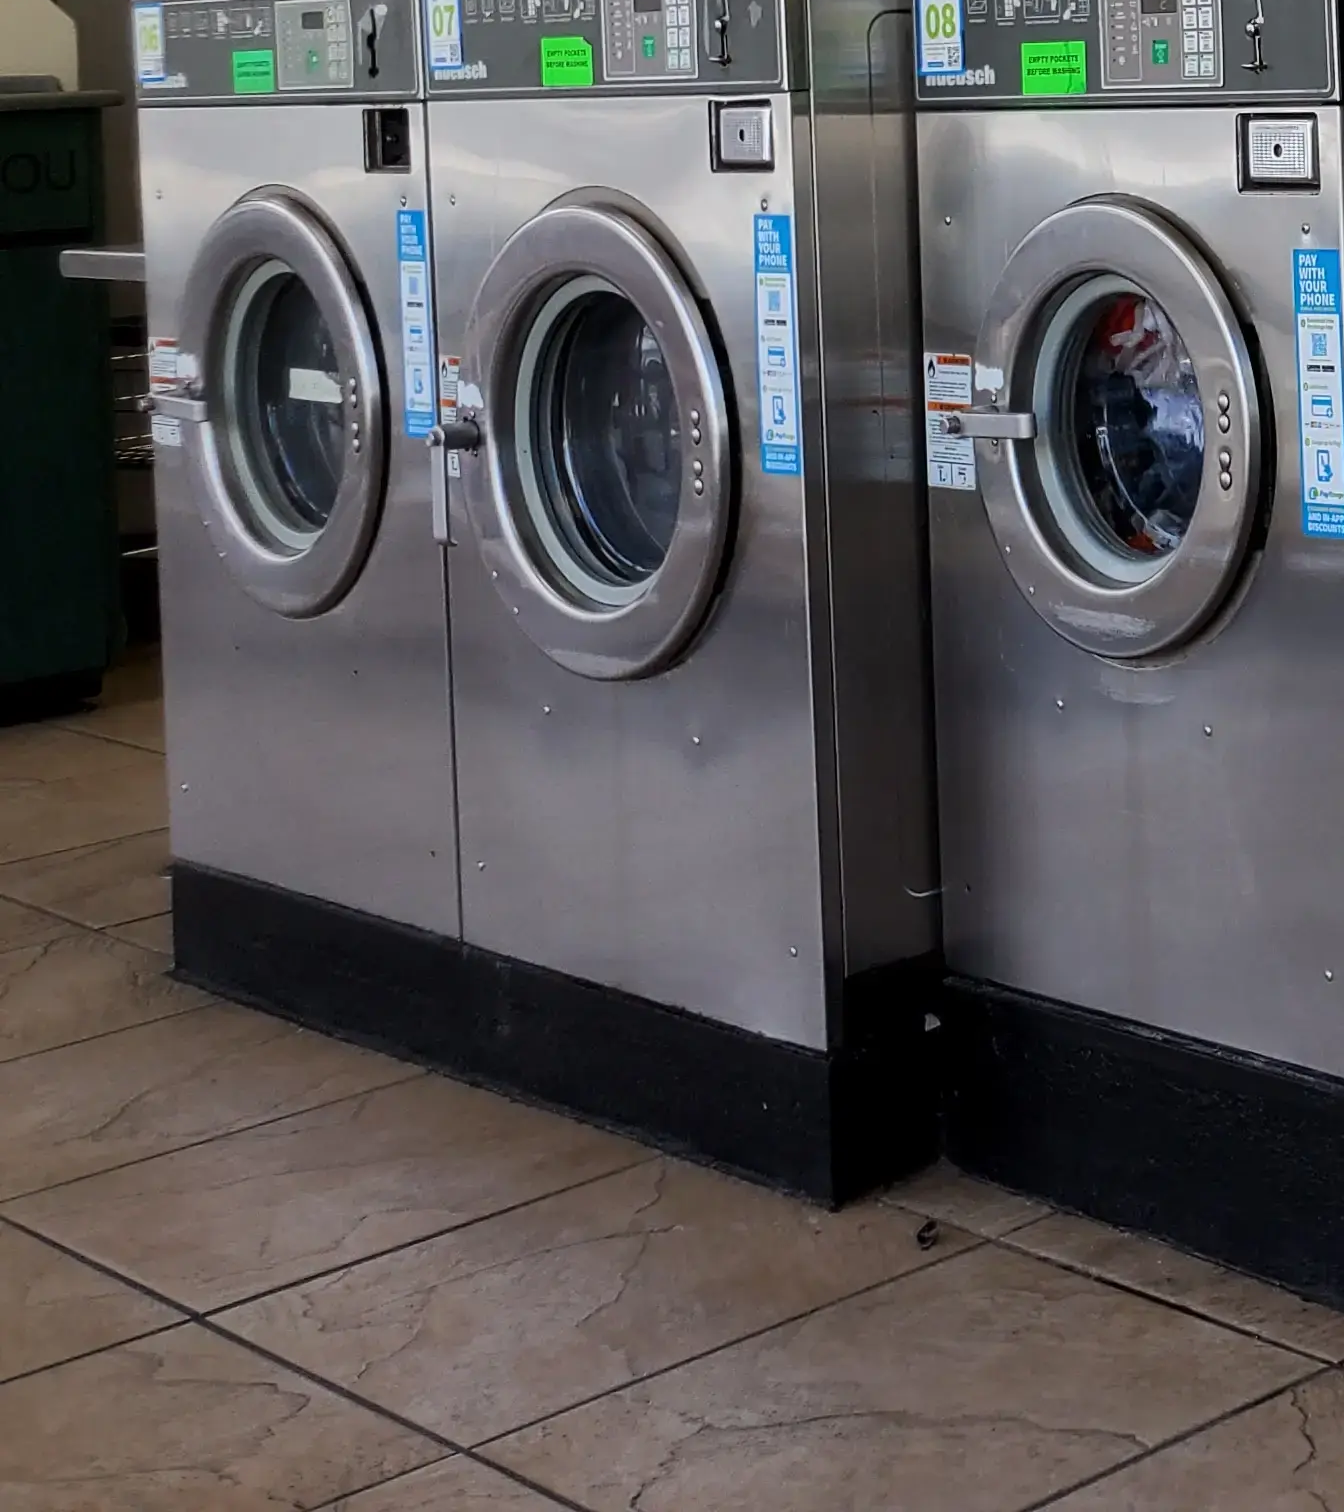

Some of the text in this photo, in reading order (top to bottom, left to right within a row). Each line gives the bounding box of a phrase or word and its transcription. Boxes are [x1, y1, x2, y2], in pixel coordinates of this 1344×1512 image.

[432, 5, 456, 37] 07
[925, 3, 956, 39] 08
[1028, 54, 1078, 64] EMPTY POCKETS
[1027, 66, 1081, 76] BEFORE WASHING
[758, 219, 773, 230] PAY
[758, 231, 779, 242] WITH
[759, 243, 781, 254] YOUR
[759, 255, 788, 267] PHONE
[1299, 254, 1317, 267] PAY
[1300, 267, 1325, 280] WITH
[1300, 281, 1328, 293] YOUR
[1300, 293, 1335, 306] PHONE
[1323, 513, 1344, 523] IN-APP
